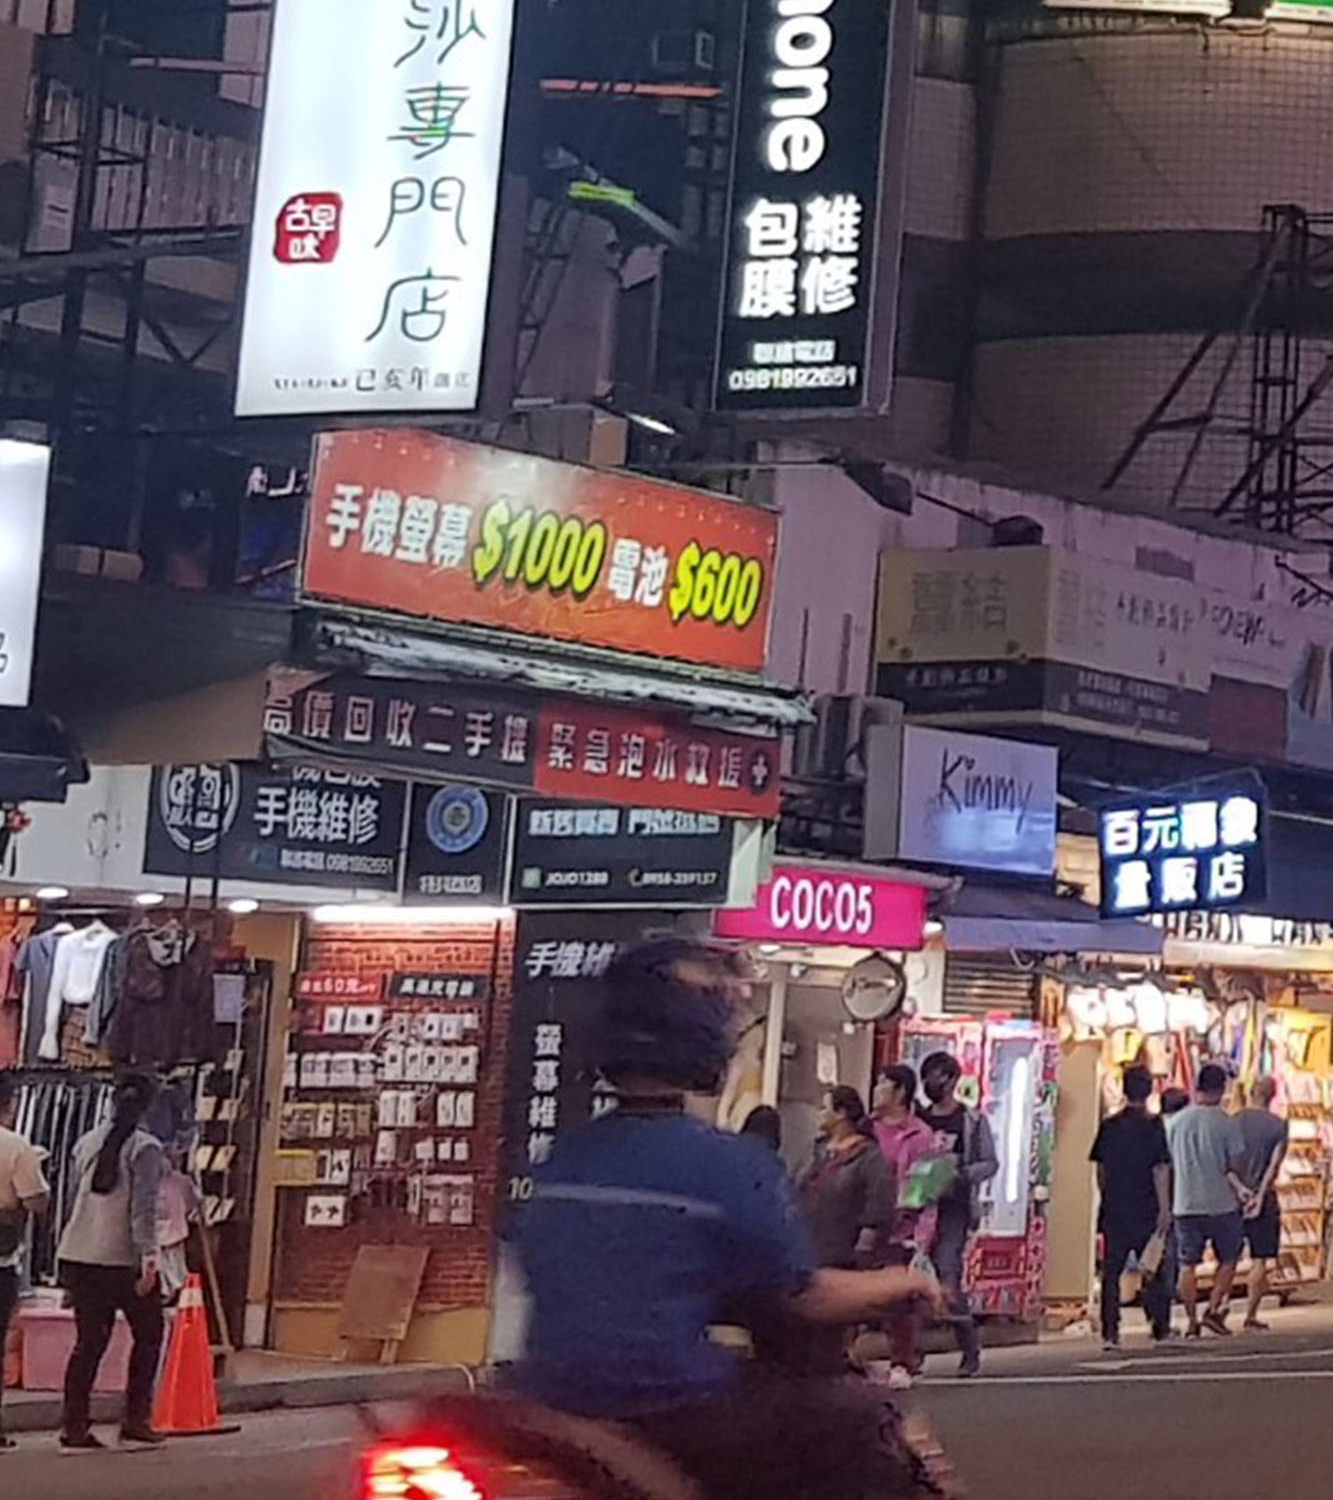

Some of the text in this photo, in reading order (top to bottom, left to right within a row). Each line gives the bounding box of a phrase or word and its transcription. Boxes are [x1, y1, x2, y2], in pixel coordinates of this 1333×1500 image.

[738, 197, 798, 319] 包膜
[798, 194, 862, 317] 維修
[325, 482, 764, 630] 手機螢幕 $1000 電池 $600
[253, 785, 381, 846] 手機維修
[939, 745, 1036, 833] Kimmy
[769, 875, 873, 935] COCO5
